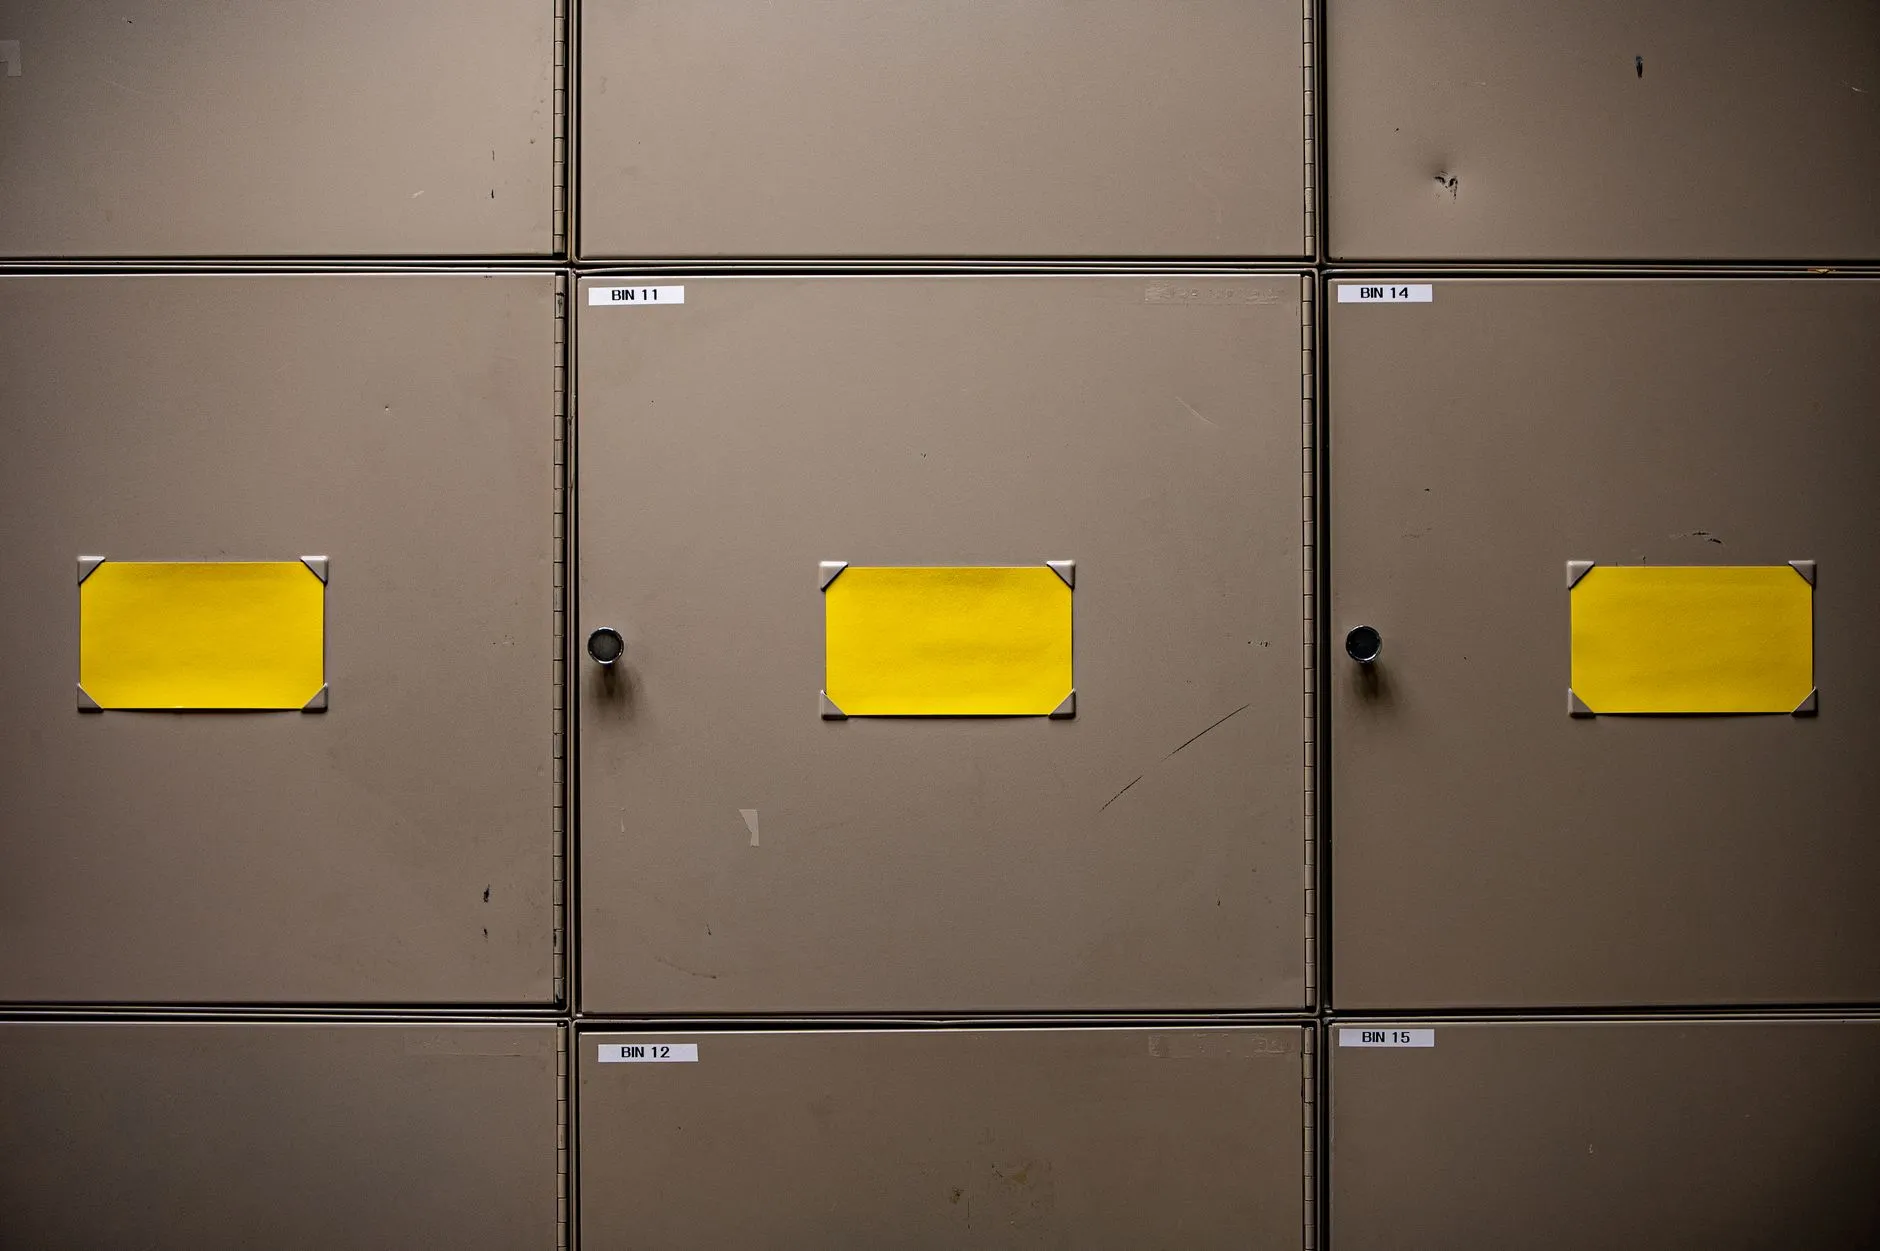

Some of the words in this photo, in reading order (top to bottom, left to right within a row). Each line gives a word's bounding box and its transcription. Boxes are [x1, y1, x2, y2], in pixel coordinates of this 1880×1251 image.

[611, 289, 635, 301] BIN
[642, 288, 657, 301] 11
[1360, 287, 1384, 299] BIN
[1390, 286, 1409, 299] 14
[1361, 1031, 1386, 1043] BIN
[1392, 1031, 1411, 1044] 15
[620, 1046, 645, 1058] BIN
[651, 1046, 670, 1059] 12
